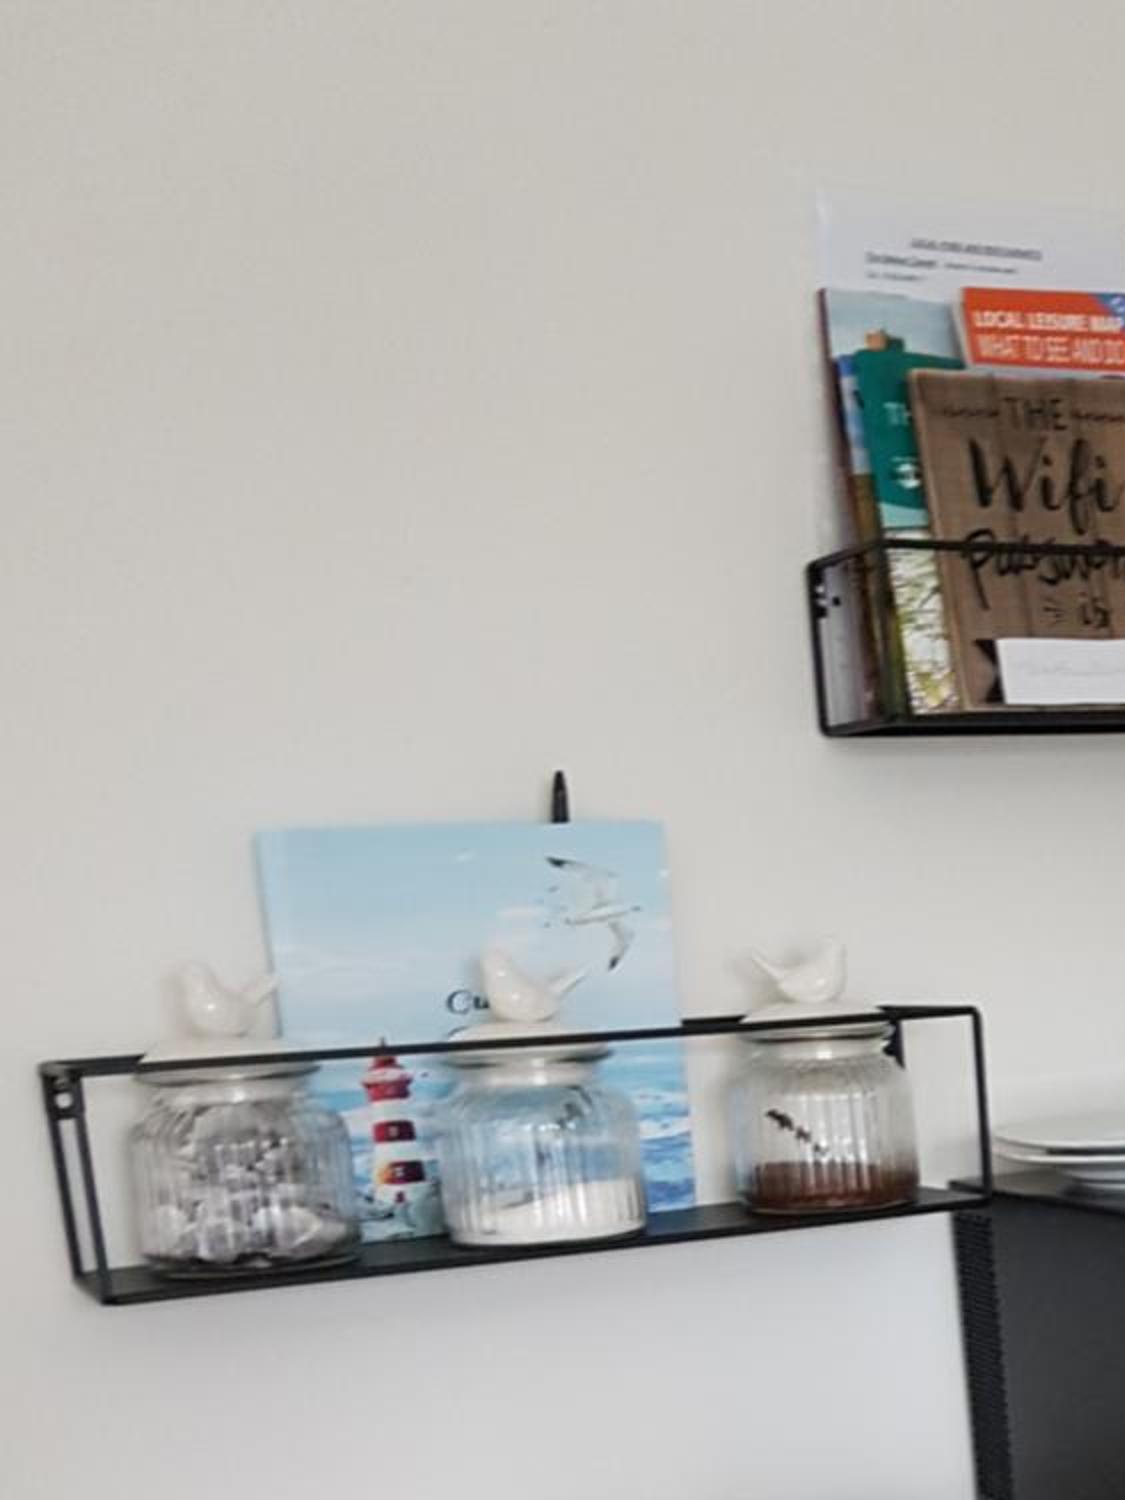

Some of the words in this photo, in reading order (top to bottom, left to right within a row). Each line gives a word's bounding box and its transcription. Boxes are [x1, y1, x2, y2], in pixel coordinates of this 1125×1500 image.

[973, 309, 1024, 329] LOCAL
[976, 333, 1021, 359] WHAT
[1073, 337, 1103, 364] AND
[1003, 397, 1068, 432] THE
[968, 435, 1125, 535] Wifi
[1079, 592, 1111, 629] is
